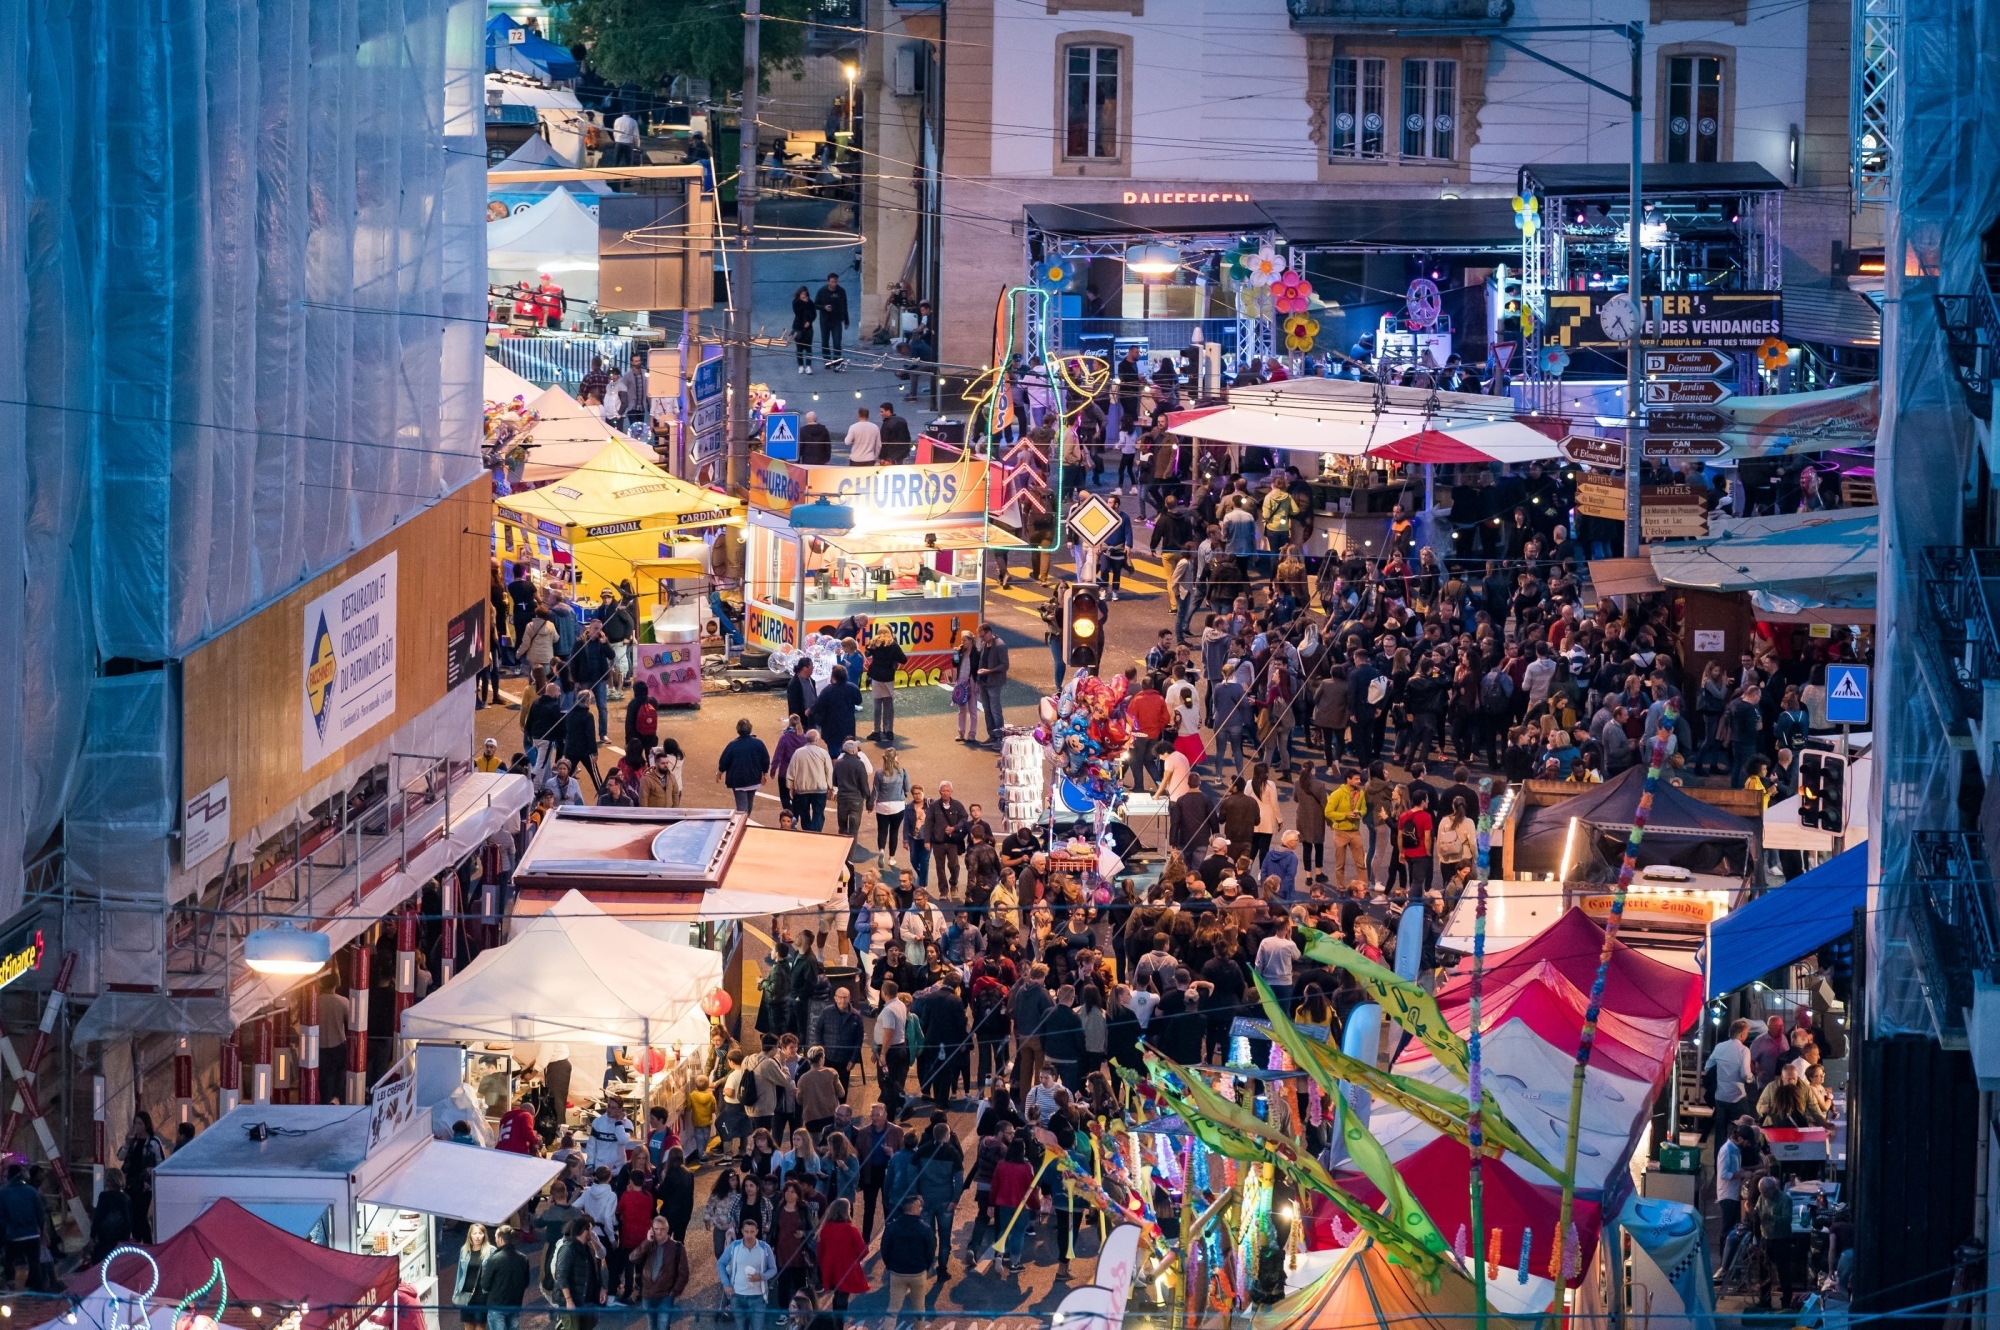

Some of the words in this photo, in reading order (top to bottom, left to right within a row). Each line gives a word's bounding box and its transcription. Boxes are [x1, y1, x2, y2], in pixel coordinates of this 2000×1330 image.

[511, 32, 522, 41] 72
[1692, 320, 1779, 335] VENDANGES
[1677, 353, 1702, 363] Centre
[1667, 363, 1712, 373] Dürrenmatt
[1678, 382, 1705, 392] Jardin
[1671, 392, 1713, 402] Botanique
[1647, 447, 1666, 455] Centre
[1669, 447, 1684, 455] d'Art
[1688, 447, 1716, 455] Neuchâtel
[756, 468, 800, 502] CHURROS
[1587, 475, 1613, 486] HOTELS
[554, 486, 582, 499] CARDINAL
[618, 484, 667, 498] CARDINAL
[838, 473, 957, 510] CHURROS
[1656, 487, 1691, 495] HOTELS
[499, 508, 522, 523] CARDINAL
[680, 509, 730, 524] CARDINAL
[1645, 517, 1660, 526] Alpes
[538, 520, 561, 536] CARDINAL
[589, 522, 639, 536] CARDINAL
[341, 579, 379, 624] RESTAURATION
[380, 573, 386, 599] ET
[341, 611, 380, 658] CONSERVATION
[750, 613, 794, 645] CHURROS
[340, 669, 349, 694] DU
[350, 644, 381, 690] PATRIMOINE
[382, 634, 393, 667] BÂTI
[642, 648, 690, 669] BARBE
[309, 660, 333, 686] FACCHINETTI
[660, 667, 696, 685] PAPA
[1588, 898, 1650, 910] Conserie
[1661, 899, 1704, 916] Sandra
[377, 1090, 386, 1101] LES
[351, 1287, 377, 1325] KEBAB
